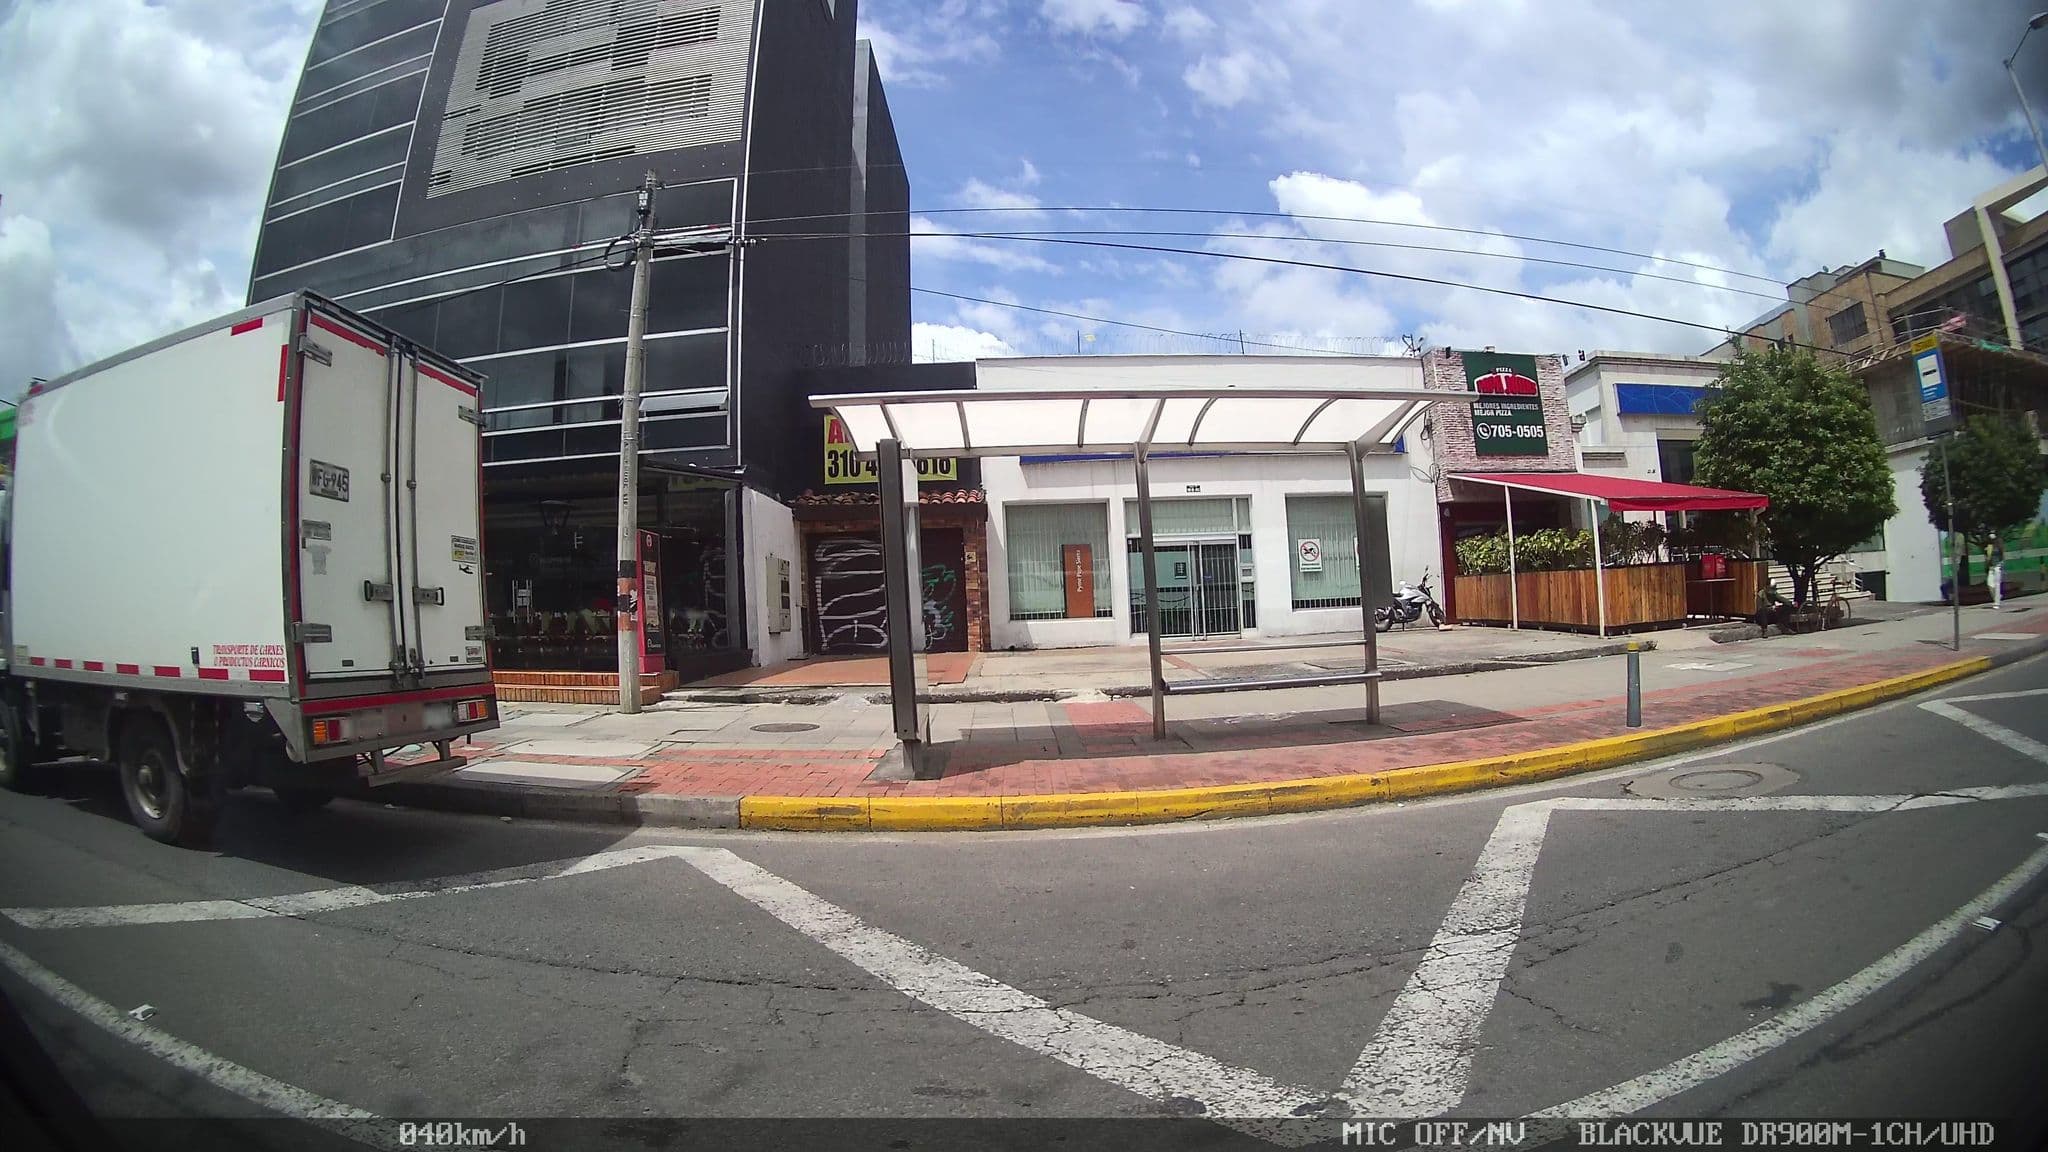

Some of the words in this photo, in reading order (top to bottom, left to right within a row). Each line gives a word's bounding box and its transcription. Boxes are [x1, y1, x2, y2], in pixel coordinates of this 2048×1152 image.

[1490, 425, 1544, 438] 705-0505
[828, 450, 860, 477] 310
[213, 645, 248, 655] TRANSPORTE
[250, 645, 258, 655] DE
[260, 645, 284, 656] CARNES
[219, 657, 253, 667] PRODUCTOS
